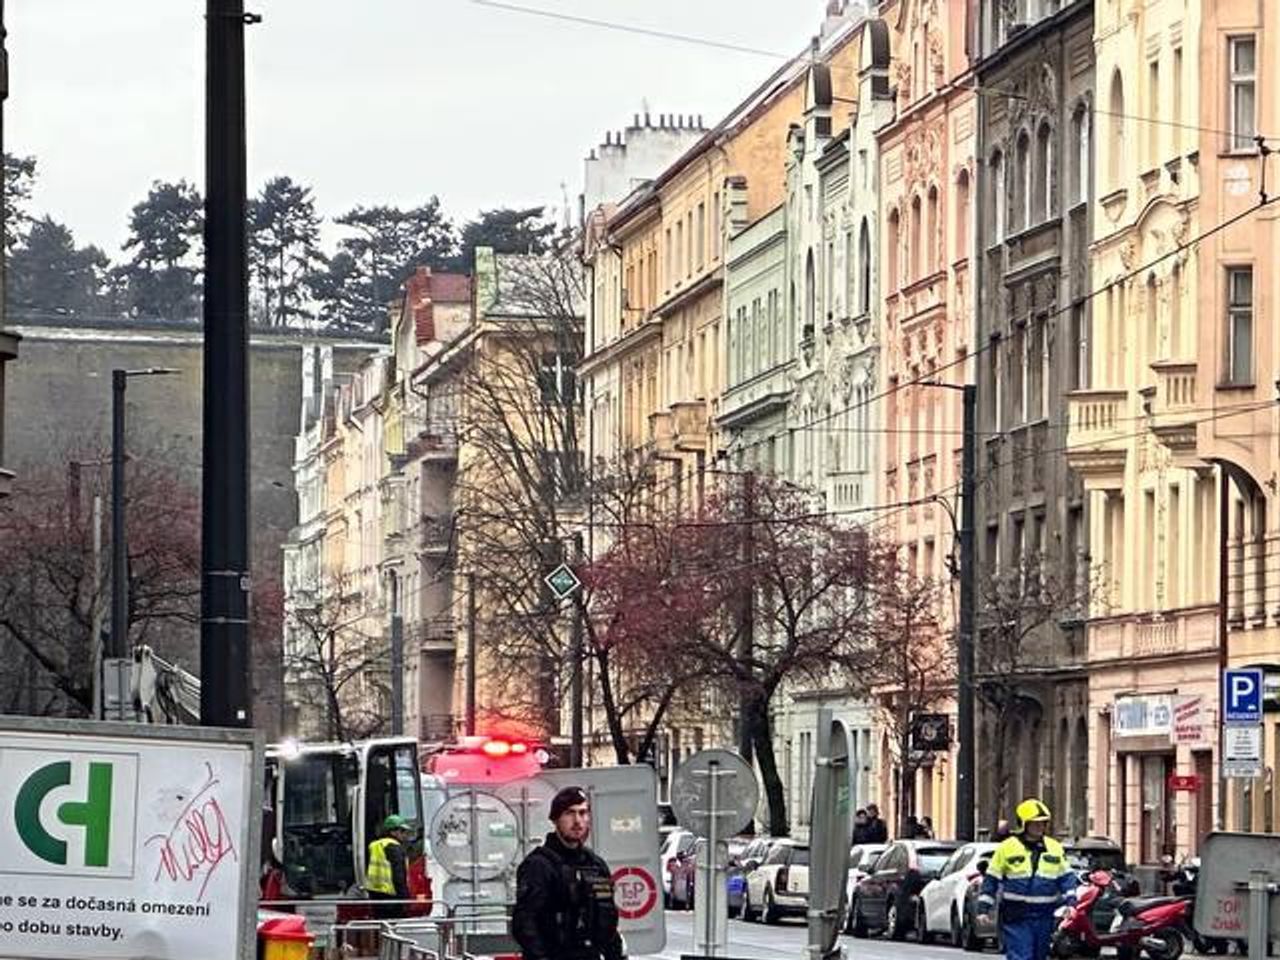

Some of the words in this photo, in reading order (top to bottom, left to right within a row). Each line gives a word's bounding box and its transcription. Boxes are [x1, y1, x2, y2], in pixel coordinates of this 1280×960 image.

[1232, 676, 1255, 707] P
[18, 896, 38, 909] se
[41, 897, 61, 910] za
[65, 895, 136, 914] dočasná
[141, 899, 210, 917] omezení
[18, 919, 62, 936] dobu
[65, 922, 124, 940] stavby.
